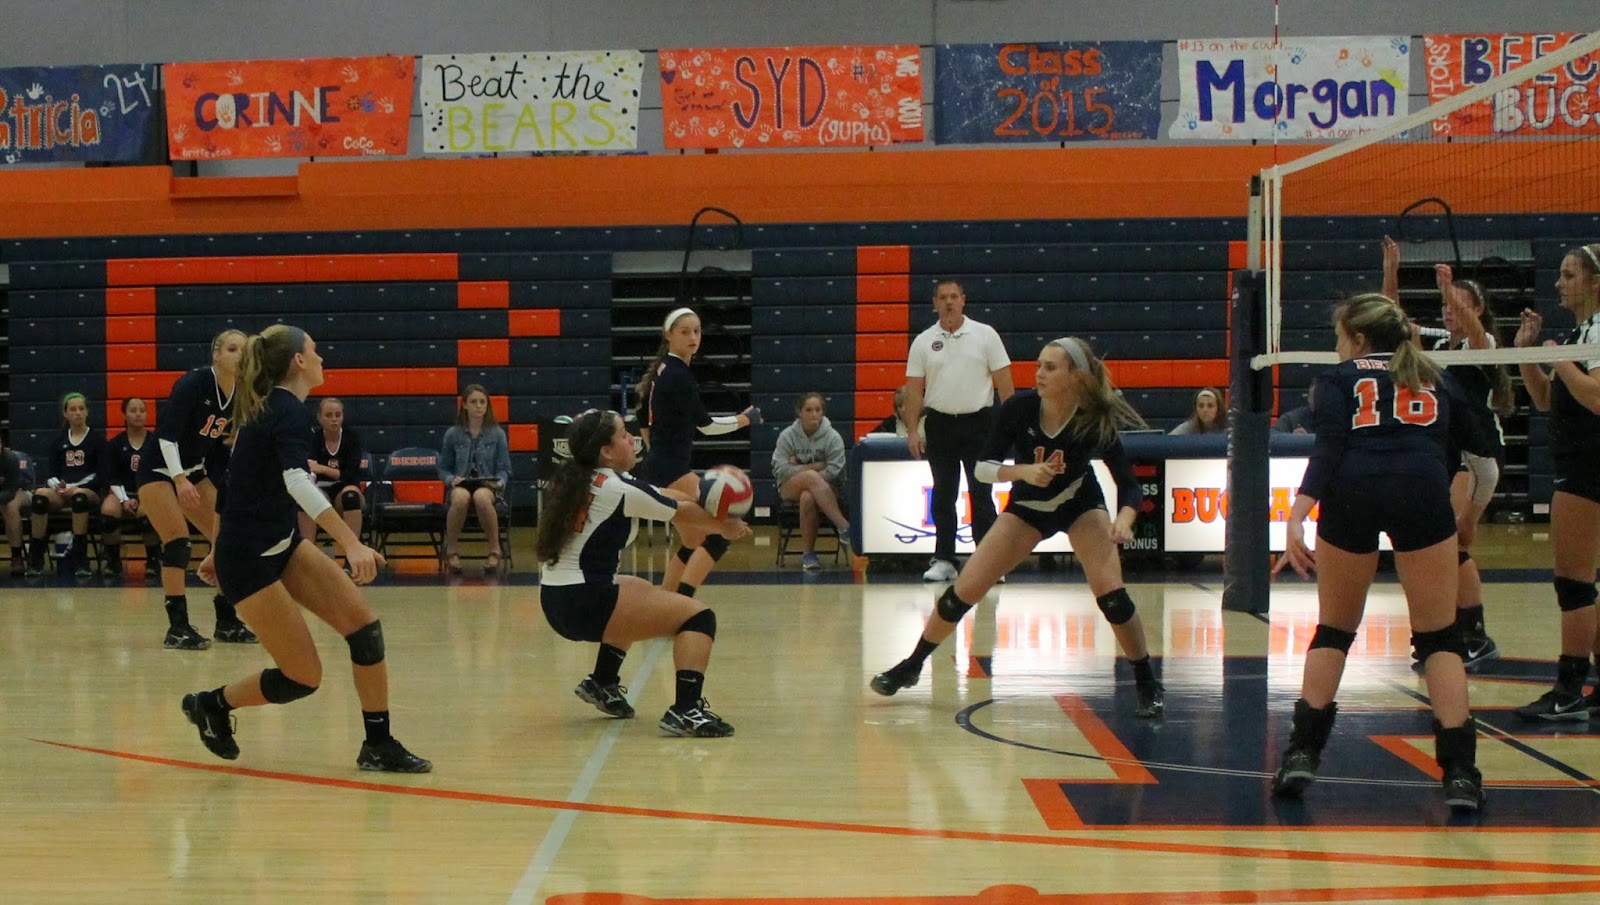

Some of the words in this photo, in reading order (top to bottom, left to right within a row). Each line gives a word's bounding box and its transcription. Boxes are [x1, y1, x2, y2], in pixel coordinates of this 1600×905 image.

[435, 61, 523, 101] Beat
[552, 61, 612, 101] the
[998, 43, 1102, 76] Class
[103, 72, 151, 115] 24
[194, 86, 341, 131] CORINNE
[732, 55, 829, 131] SYD
[994, 87, 1115, 136] 2015
[1196, 59, 1395, 129] Morgan
[447, 102, 616, 151] BEARS
[1352, 377, 1438, 430] 16
[199, 414, 228, 439] 13
[1034, 446, 1066, 474] 14
